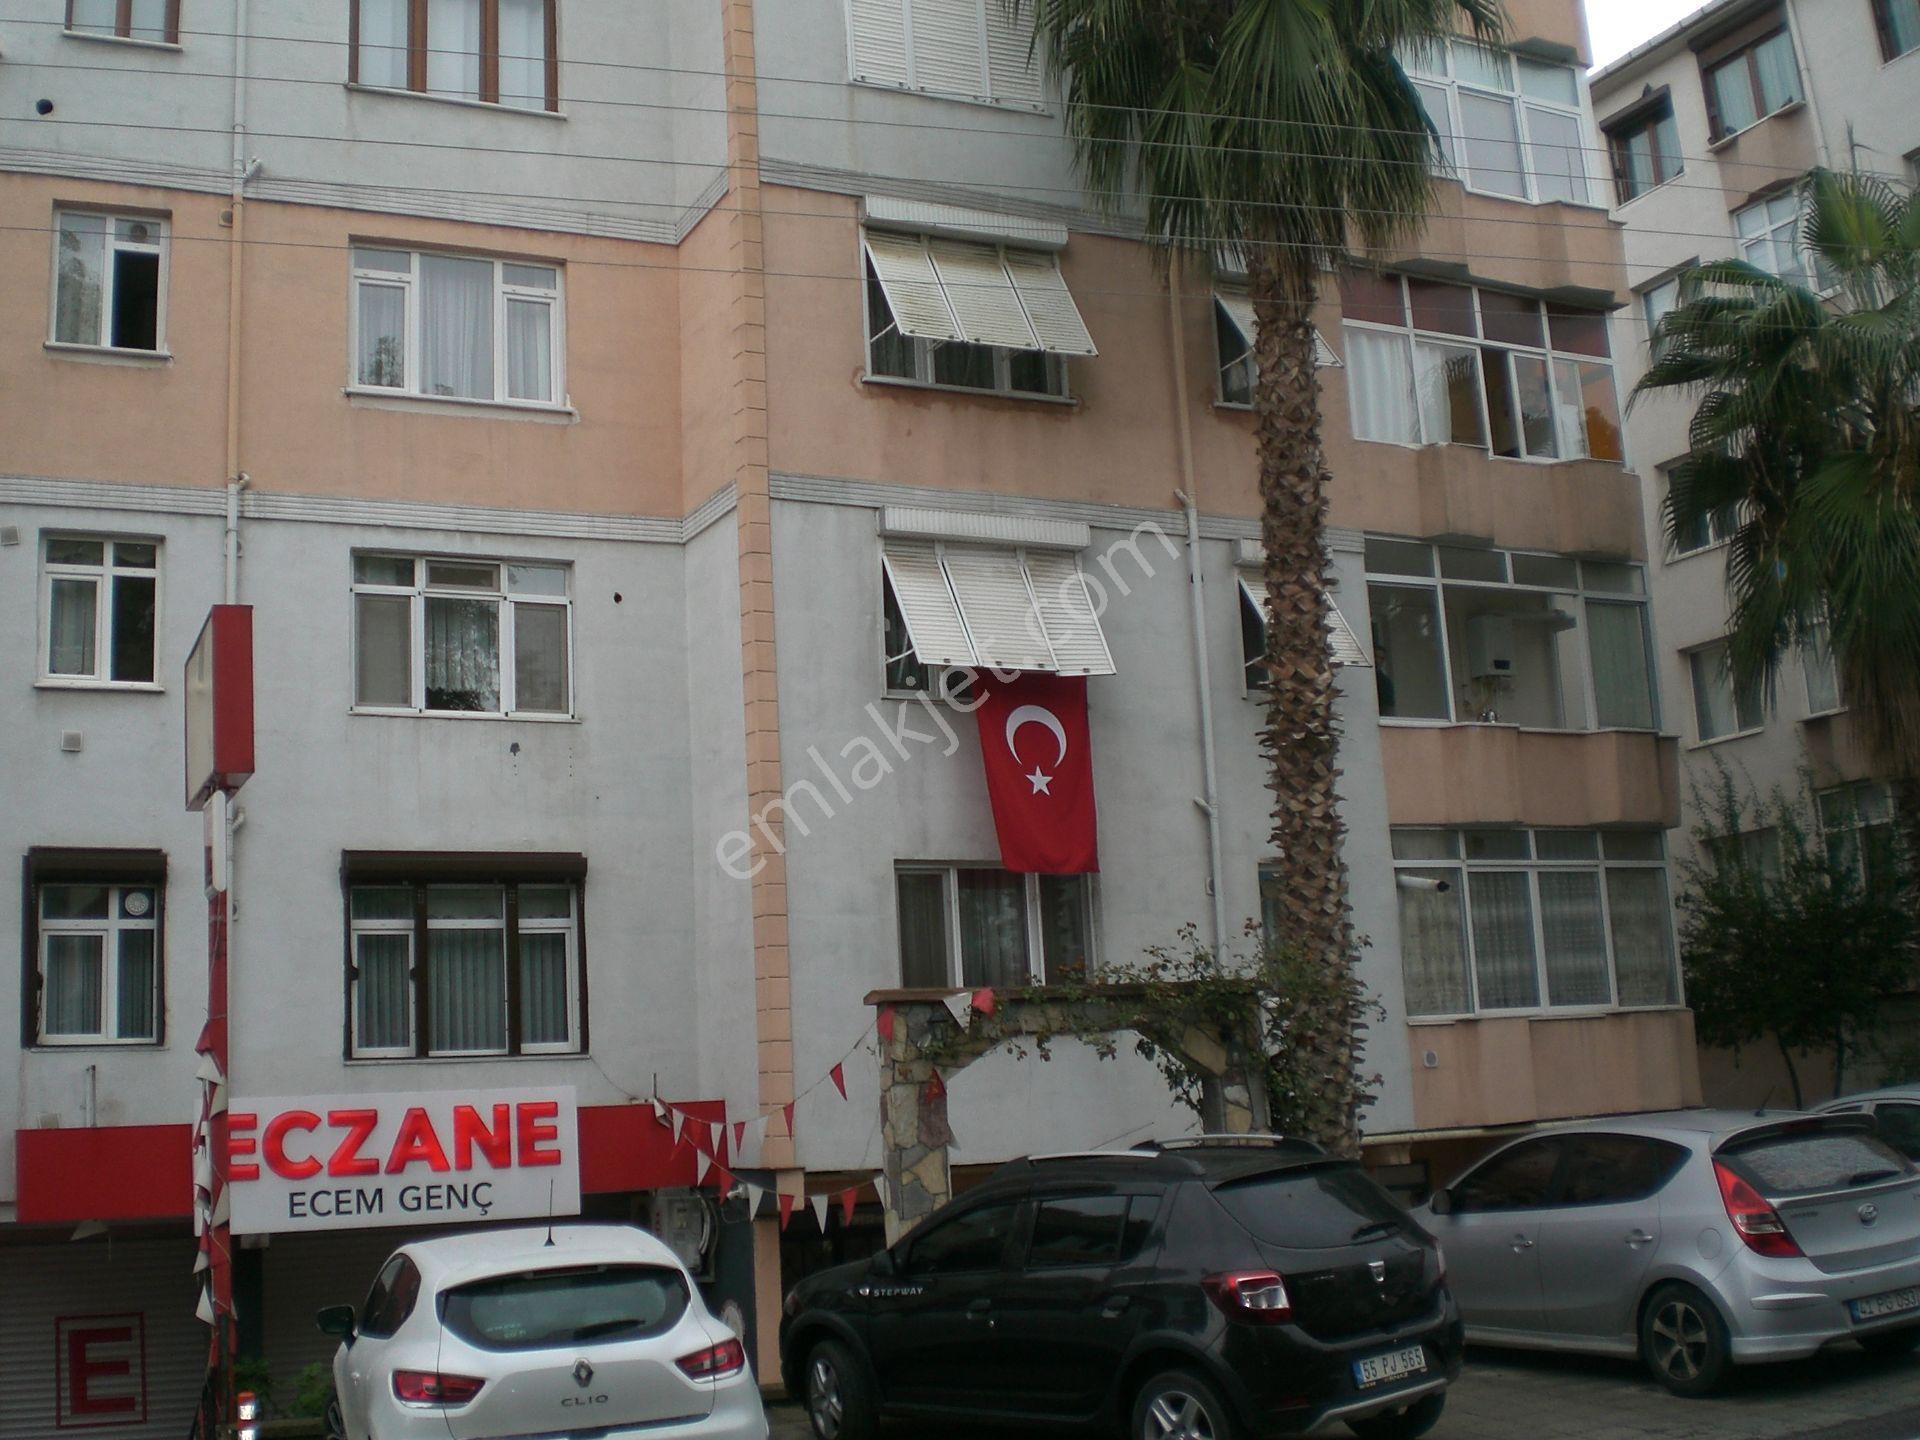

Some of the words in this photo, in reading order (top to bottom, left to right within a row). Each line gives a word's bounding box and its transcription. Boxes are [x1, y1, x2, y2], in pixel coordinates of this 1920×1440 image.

[229, 1101, 561, 1182] ECZANE
[288, 1188, 383, 1219] ECEM
[399, 1182, 493, 1217] GENÇ
[873, 1287, 924, 1298] STEPWAY
[68, 1326, 135, 1415] E
[1382, 1354, 1397, 1374] PJ
[561, 1394, 609, 1407] CLIO
